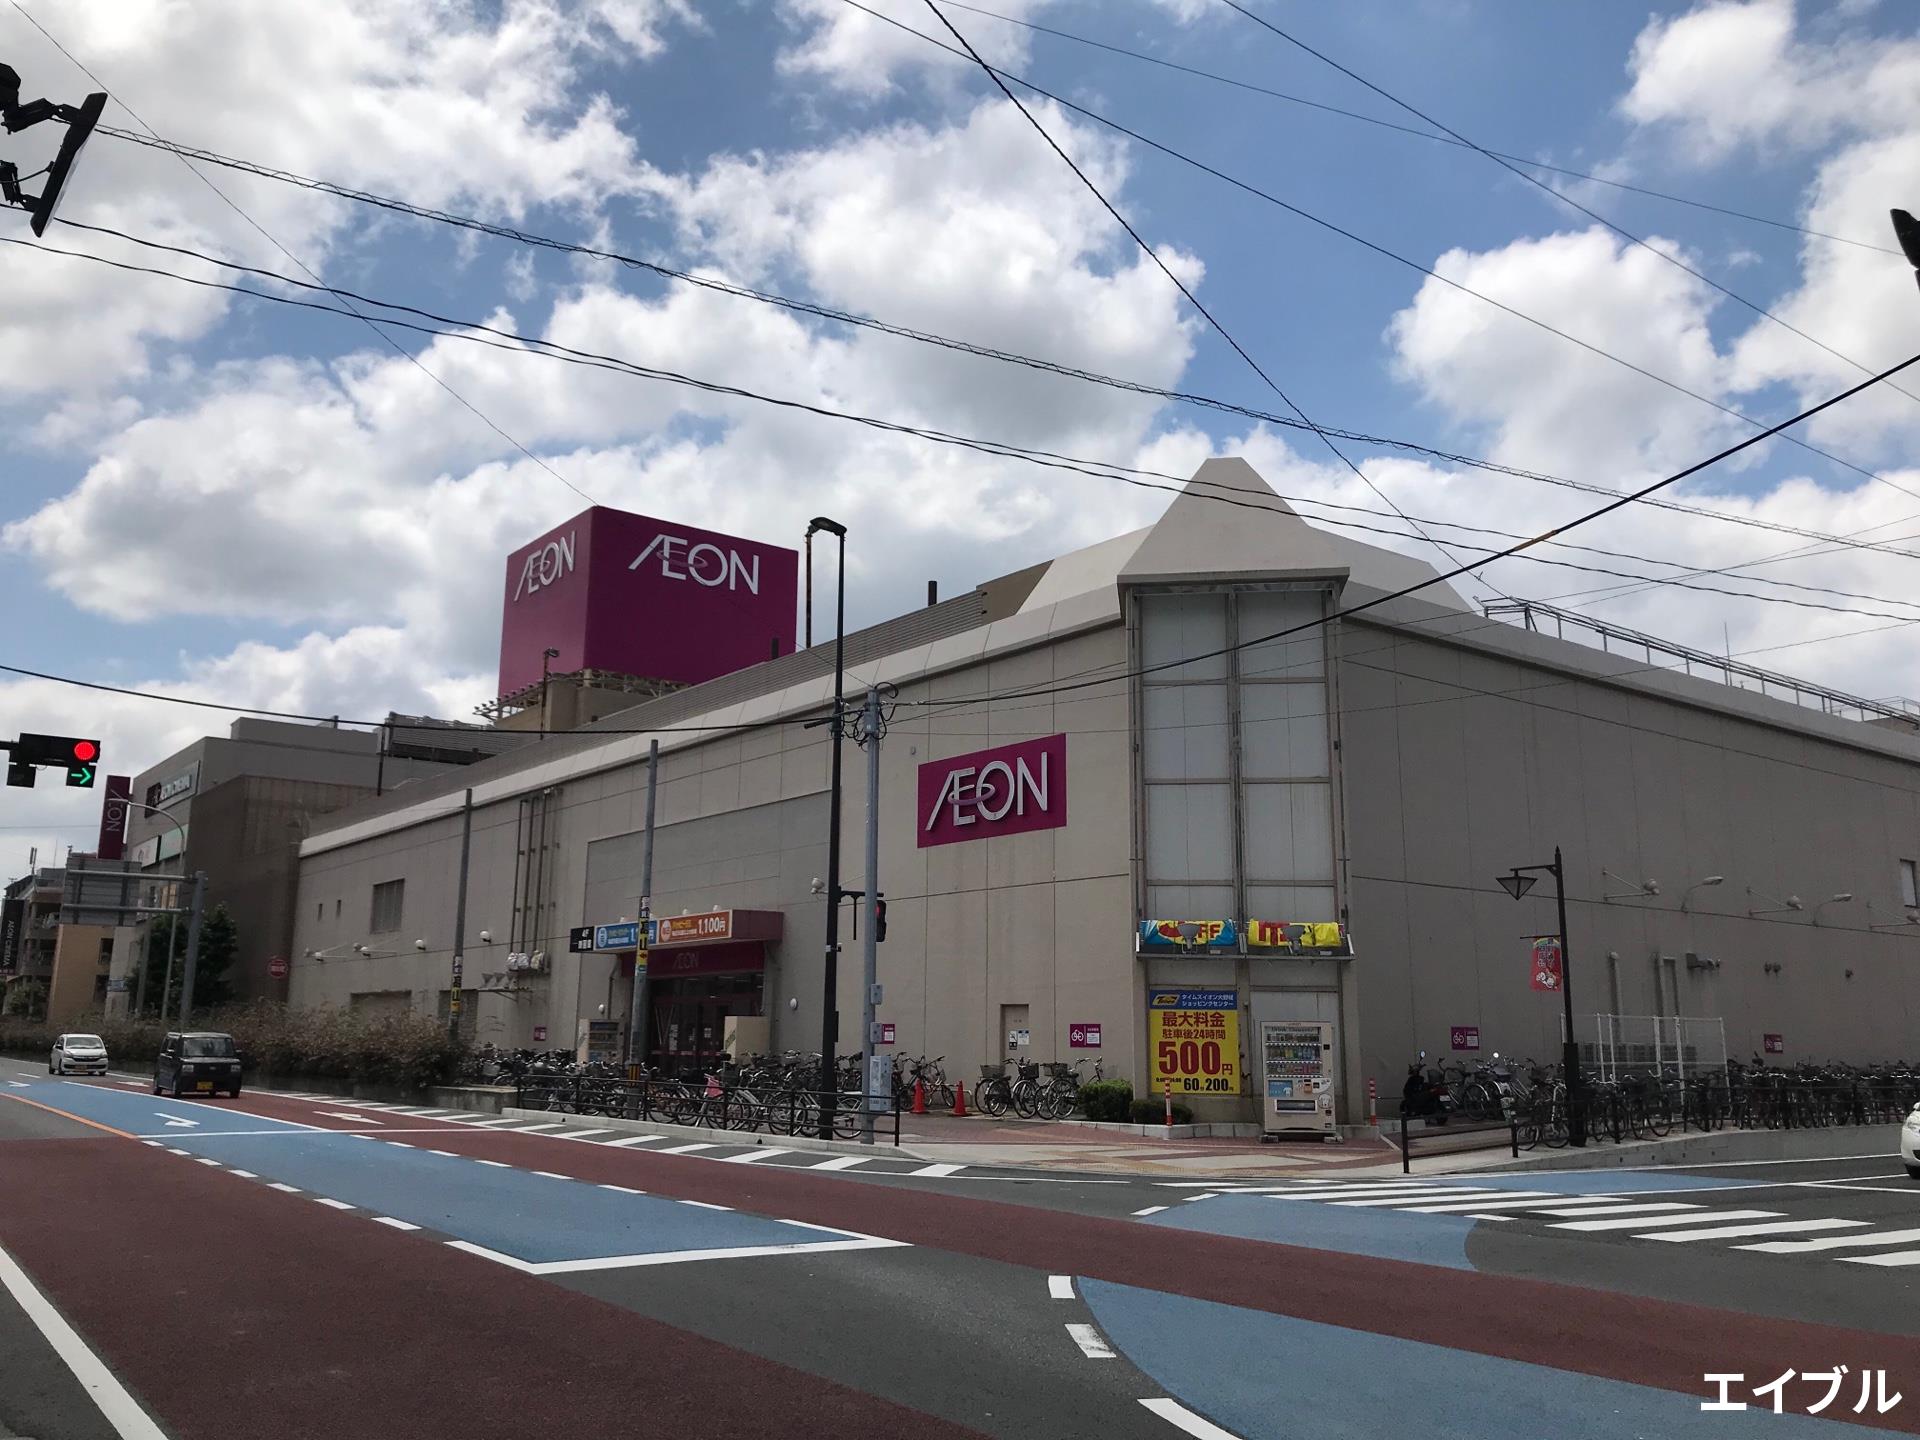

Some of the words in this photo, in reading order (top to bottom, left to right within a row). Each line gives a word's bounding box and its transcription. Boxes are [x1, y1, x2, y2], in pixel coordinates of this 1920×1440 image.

[1162, 1011, 1225, 1028] 最大料金
[1162, 1029, 1226, 1040] 駐車後24時間
[1158, 1041, 1233, 1076] 500円
